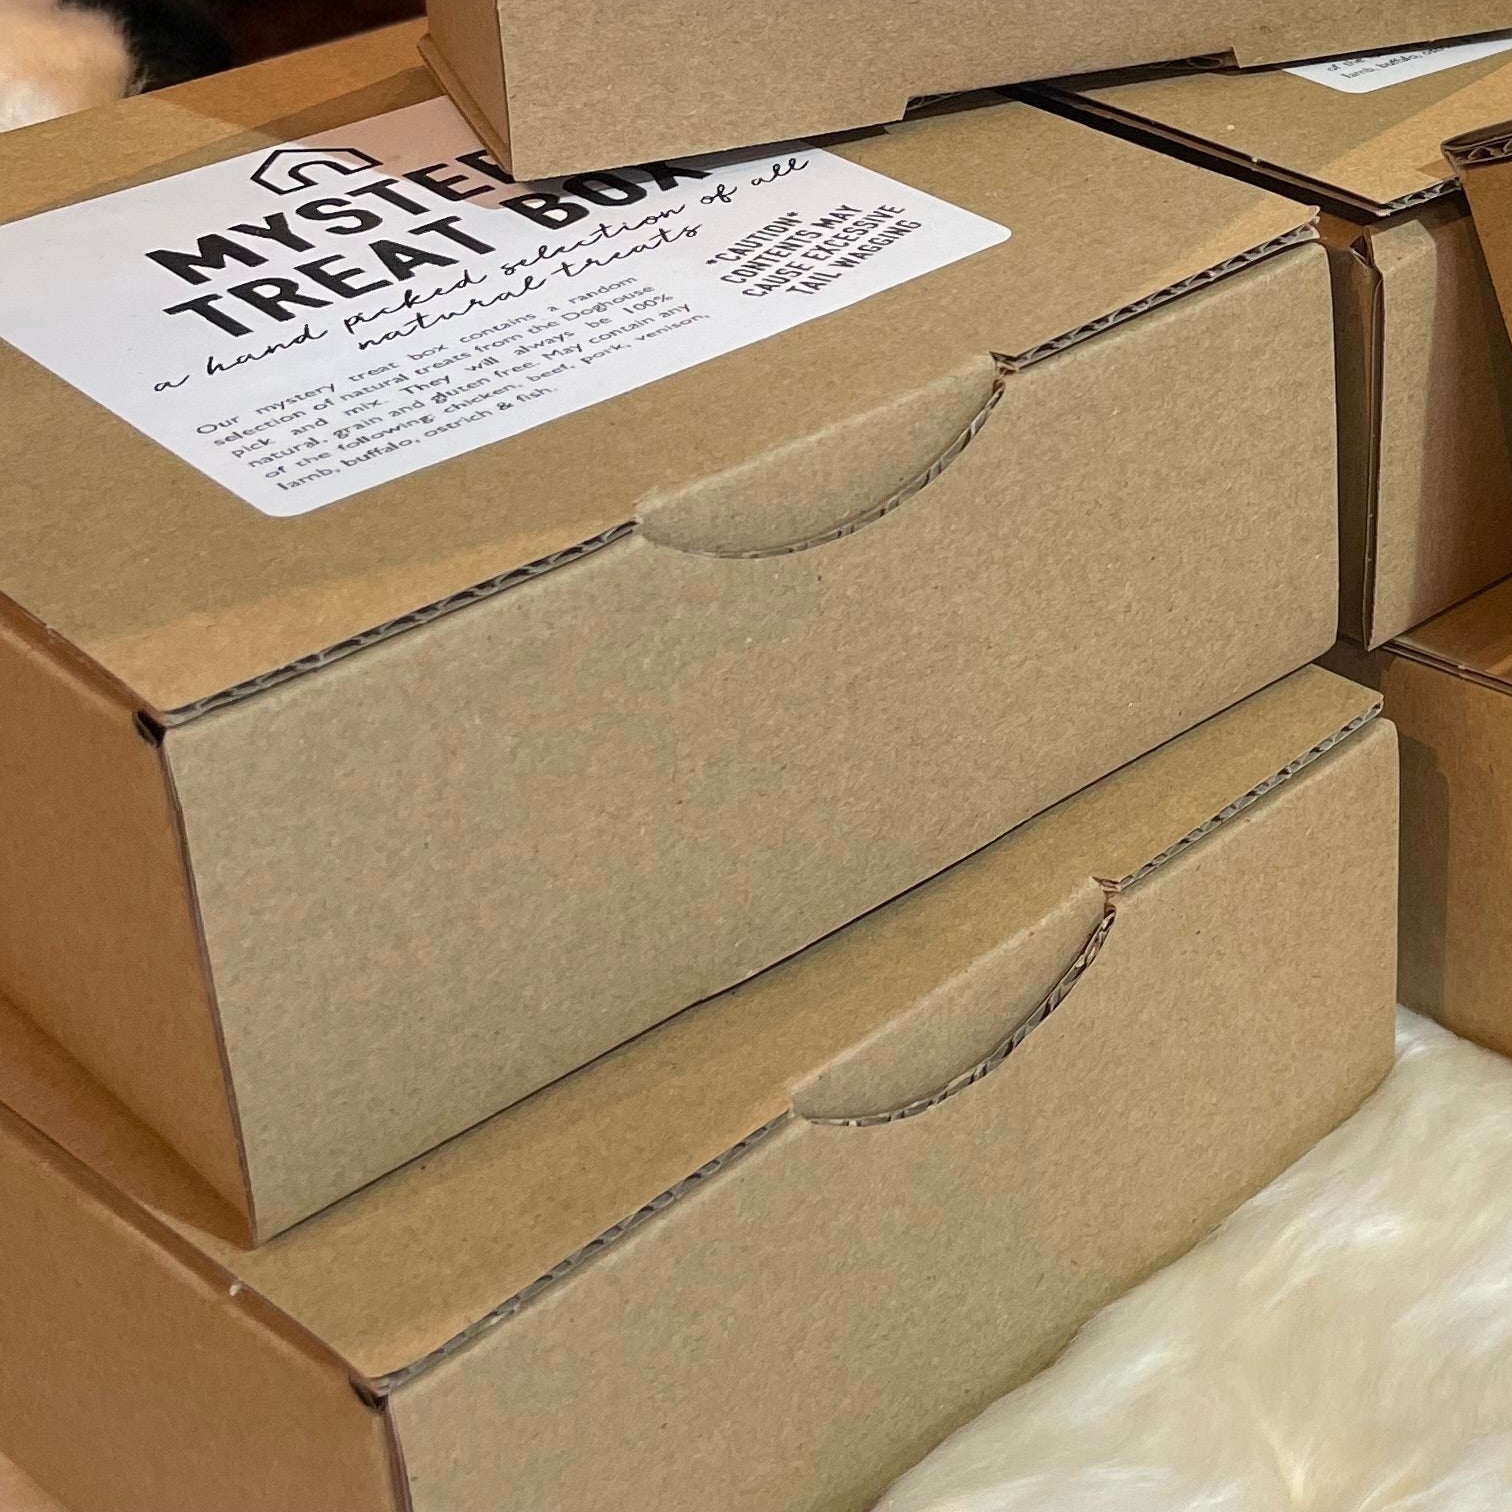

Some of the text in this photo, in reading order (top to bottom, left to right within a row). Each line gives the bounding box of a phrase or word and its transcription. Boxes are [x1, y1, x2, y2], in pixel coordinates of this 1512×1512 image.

[156, 159, 810, 392] a hand picked selection of all
[164, 215, 498, 338] TREAT
[358, 224, 703, 349] natural treats
[719, 205, 864, 283] CONTENTS MAY
[741, 206, 907, 297] CAUSE EXCESSIVE
[786, 221, 923, 294] TAIL WAGGING
[198, 417, 241, 434] Our
[256, 384, 335, 415] mystery
[349, 362, 400, 381] treat
[407, 345, 449, 360] box
[459, 314, 536, 342] contains
[568, 278, 637, 303] random
[215, 287, 655, 446] selection of natural treats from the Doghouse
[232, 293, 673, 459] pick and mix. They will always be 100%
